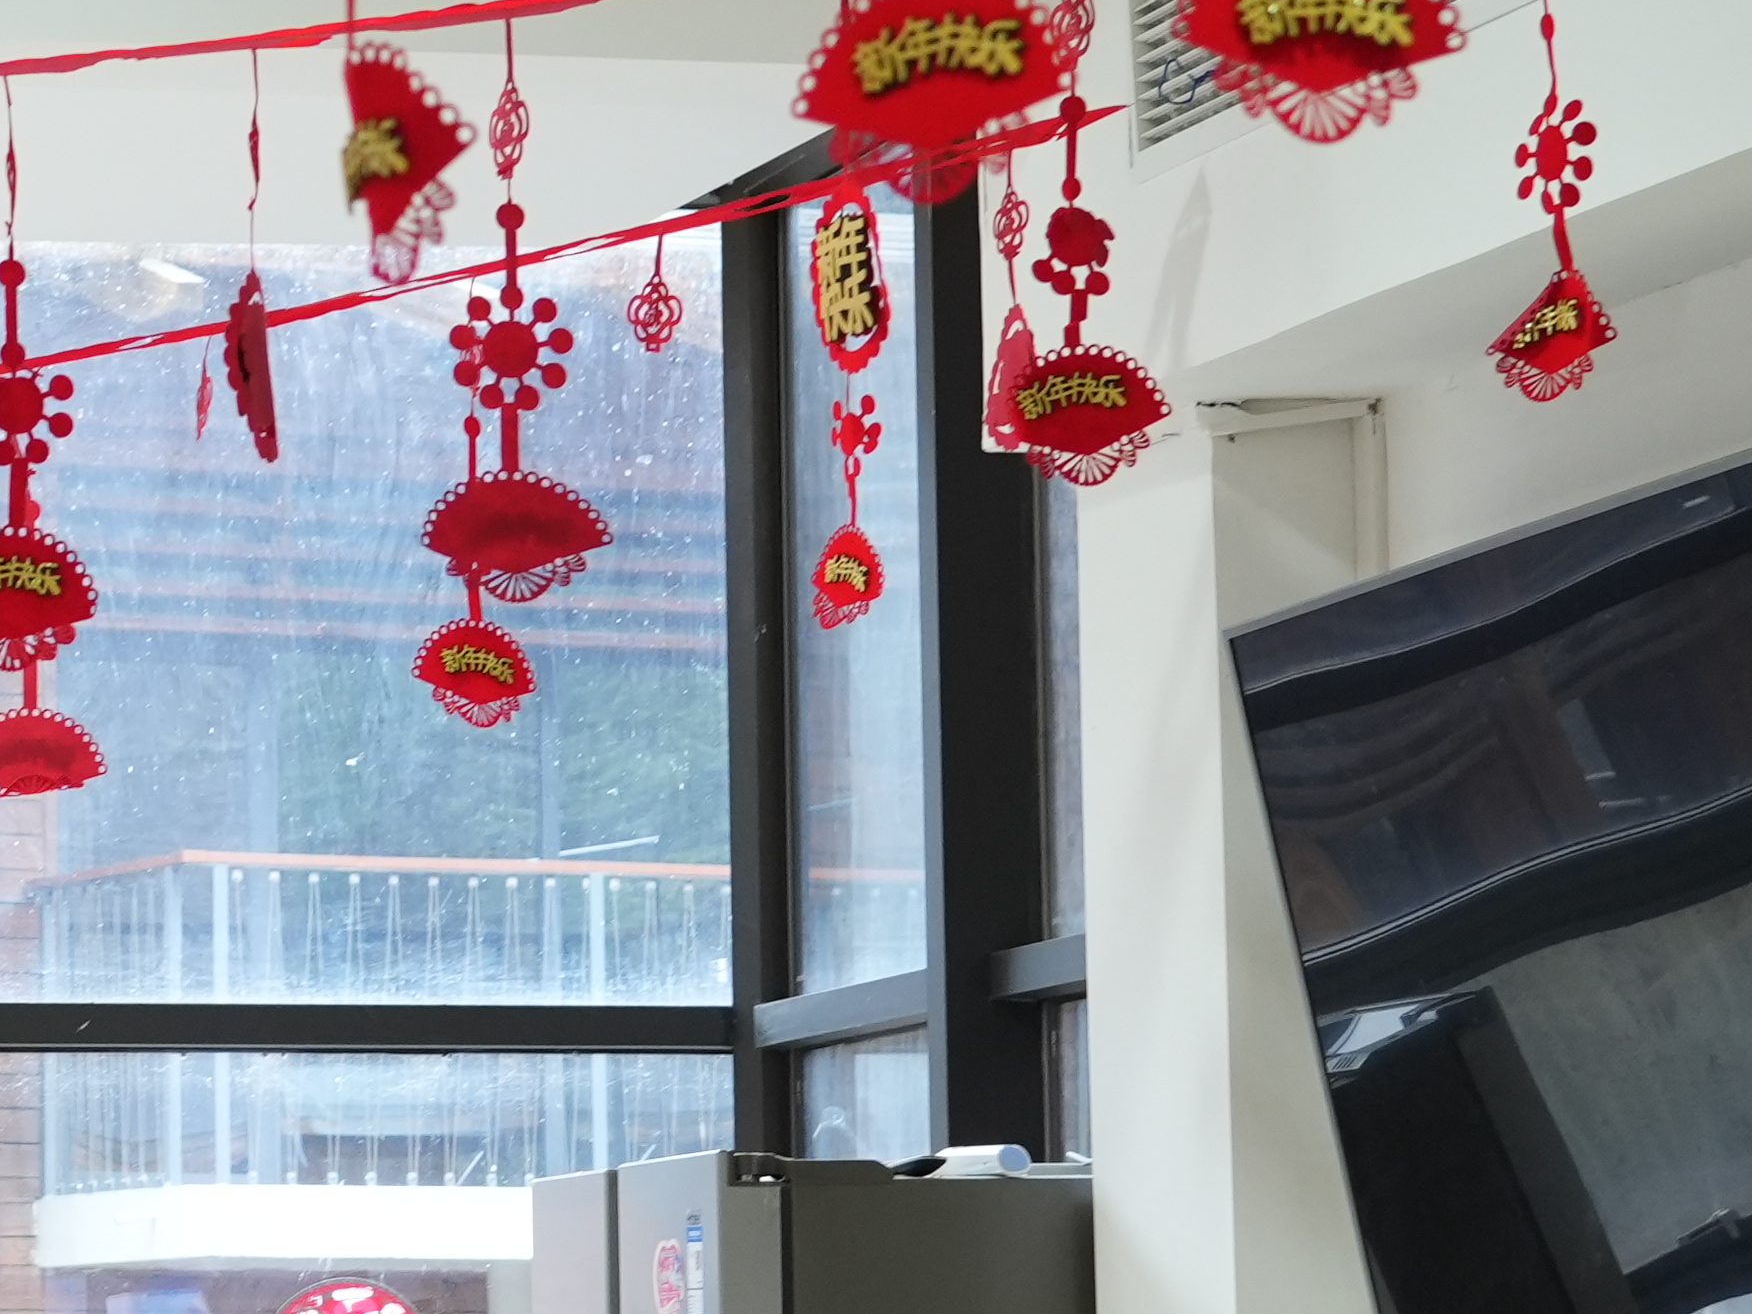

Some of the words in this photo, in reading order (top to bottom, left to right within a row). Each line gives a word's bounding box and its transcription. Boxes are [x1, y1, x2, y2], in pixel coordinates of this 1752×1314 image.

[853, 12, 1023, 95] 新年快乐
[1016, 371, 1127, 419] 新年快乐
[440, 645, 514, 684] 新年快乐
